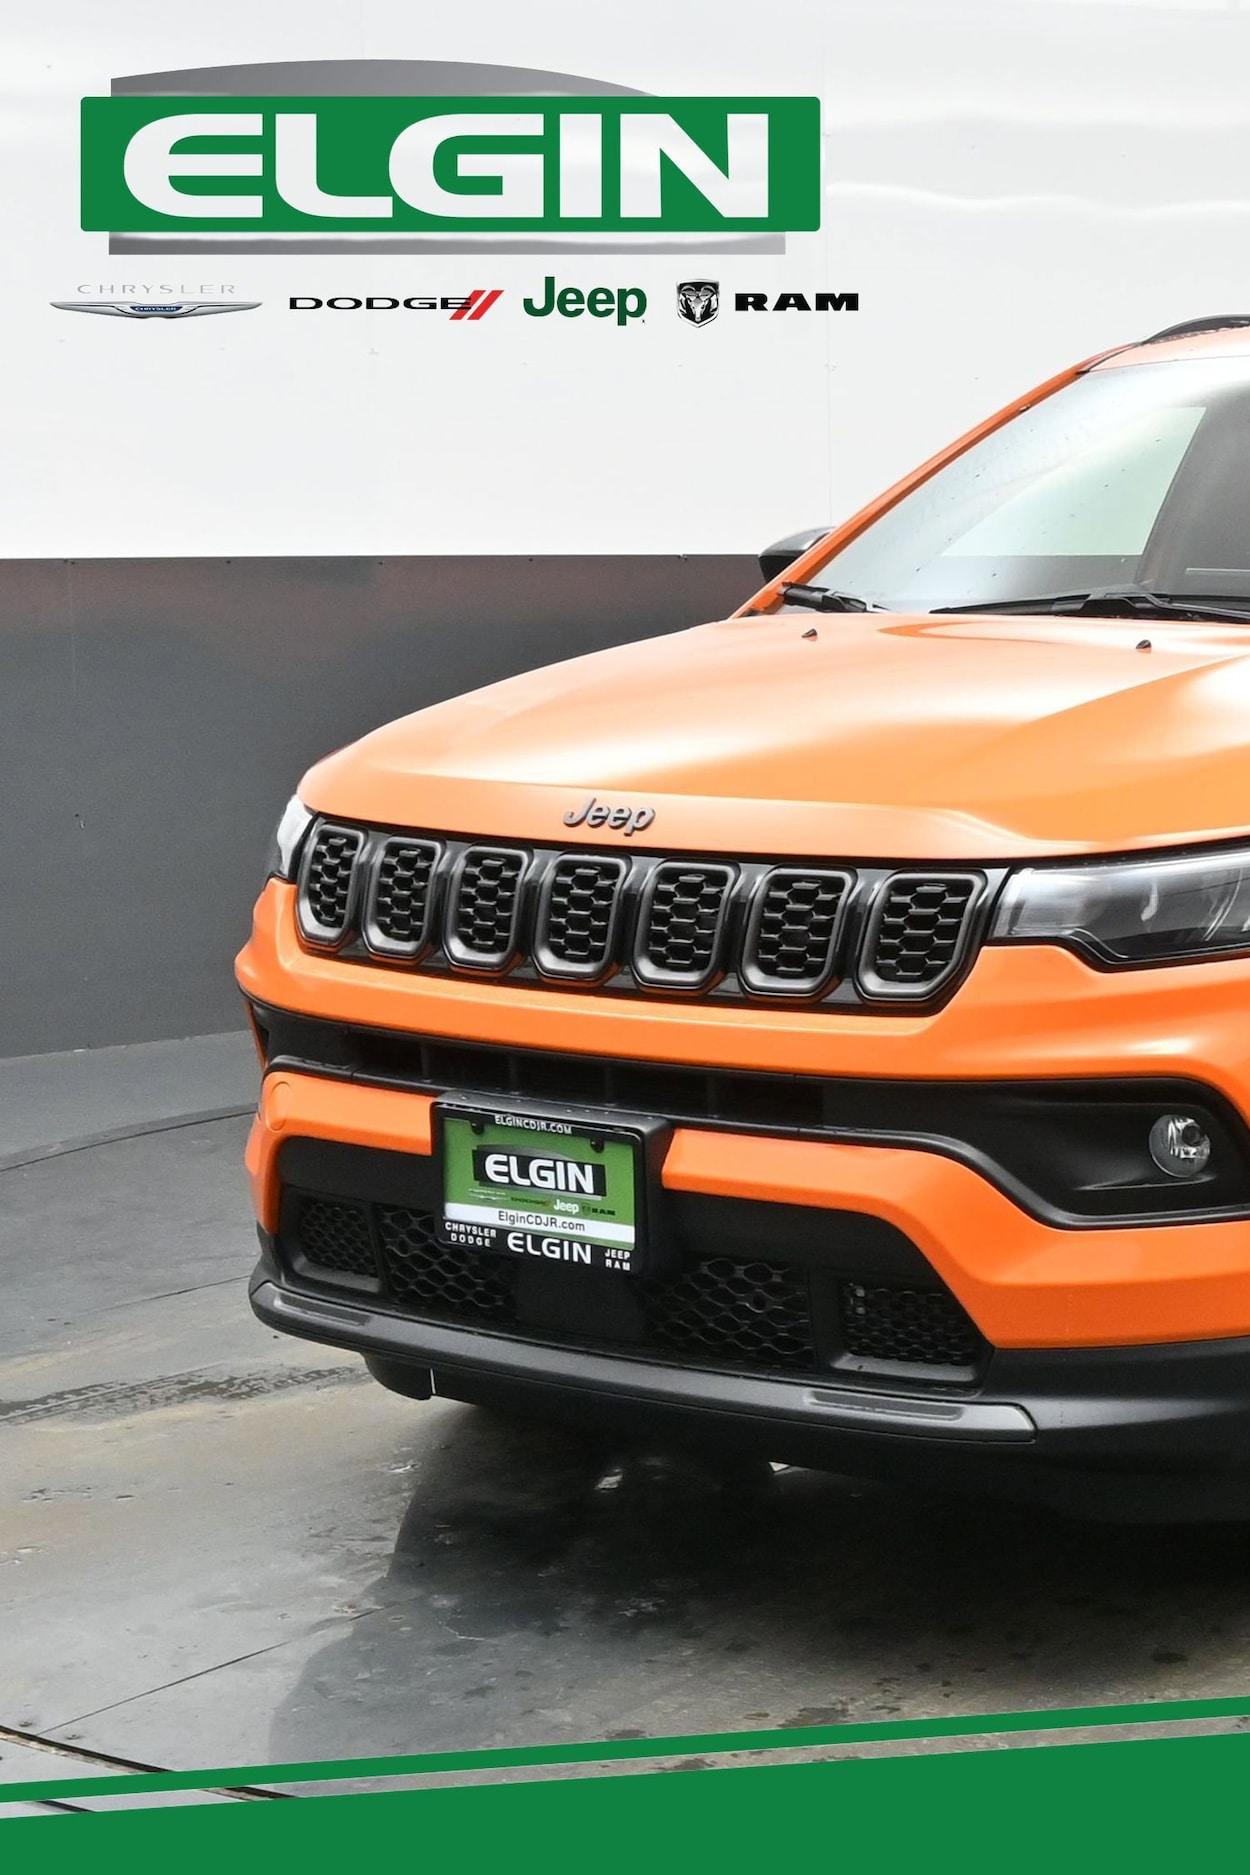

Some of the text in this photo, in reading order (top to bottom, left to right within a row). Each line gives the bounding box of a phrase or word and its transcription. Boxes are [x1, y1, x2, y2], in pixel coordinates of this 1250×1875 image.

[563, 797, 656, 837] Jeep
[495, 1114, 573, 1135] ELGINCDJR.COM
[485, 1153, 595, 1194] ELGIN
[553, 1199, 580, 1215] Jeep
[591, 1207, 616, 1216] RAM
[445, 1220, 497, 1239] CHRYSLER
[498, 1210, 586, 1232] ElginCDJR.com
[451, 1233, 492, 1248] DODGE
[507, 1231, 592, 1265] ELGIN
[605, 1248, 631, 1260] JEEP
[605, 1259, 631, 1271] RAM
